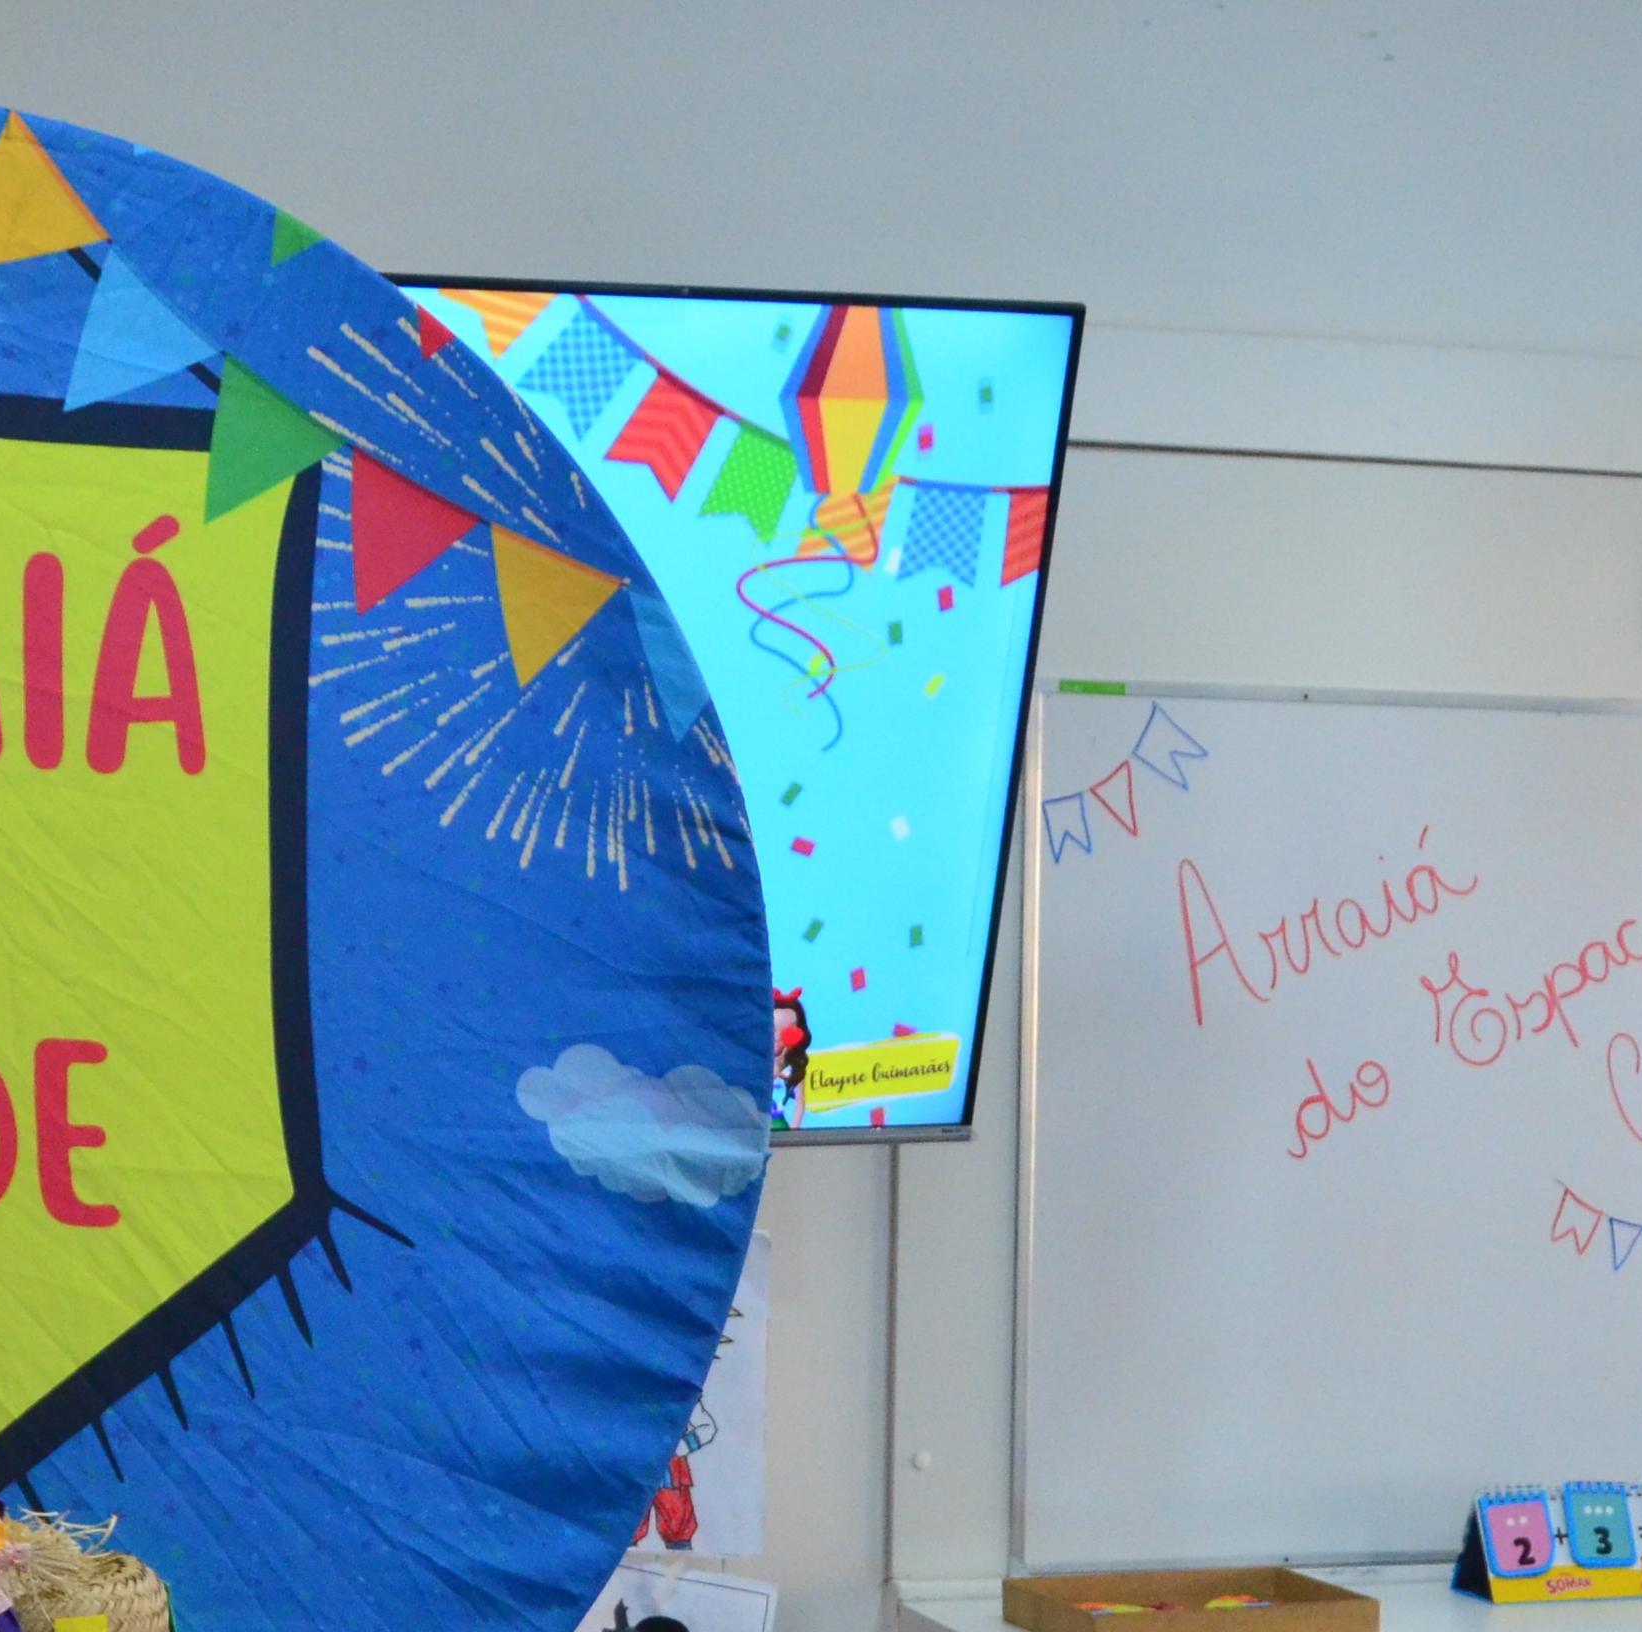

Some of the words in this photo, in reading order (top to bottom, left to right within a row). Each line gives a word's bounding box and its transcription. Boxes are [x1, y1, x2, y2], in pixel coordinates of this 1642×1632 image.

[1176, 824, 1478, 1027] Arraiá
[1286, 1057, 1390, 1159] do
[1513, 1536, 1536, 1566] 2
[1593, 1526, 1613, 1555] 3
